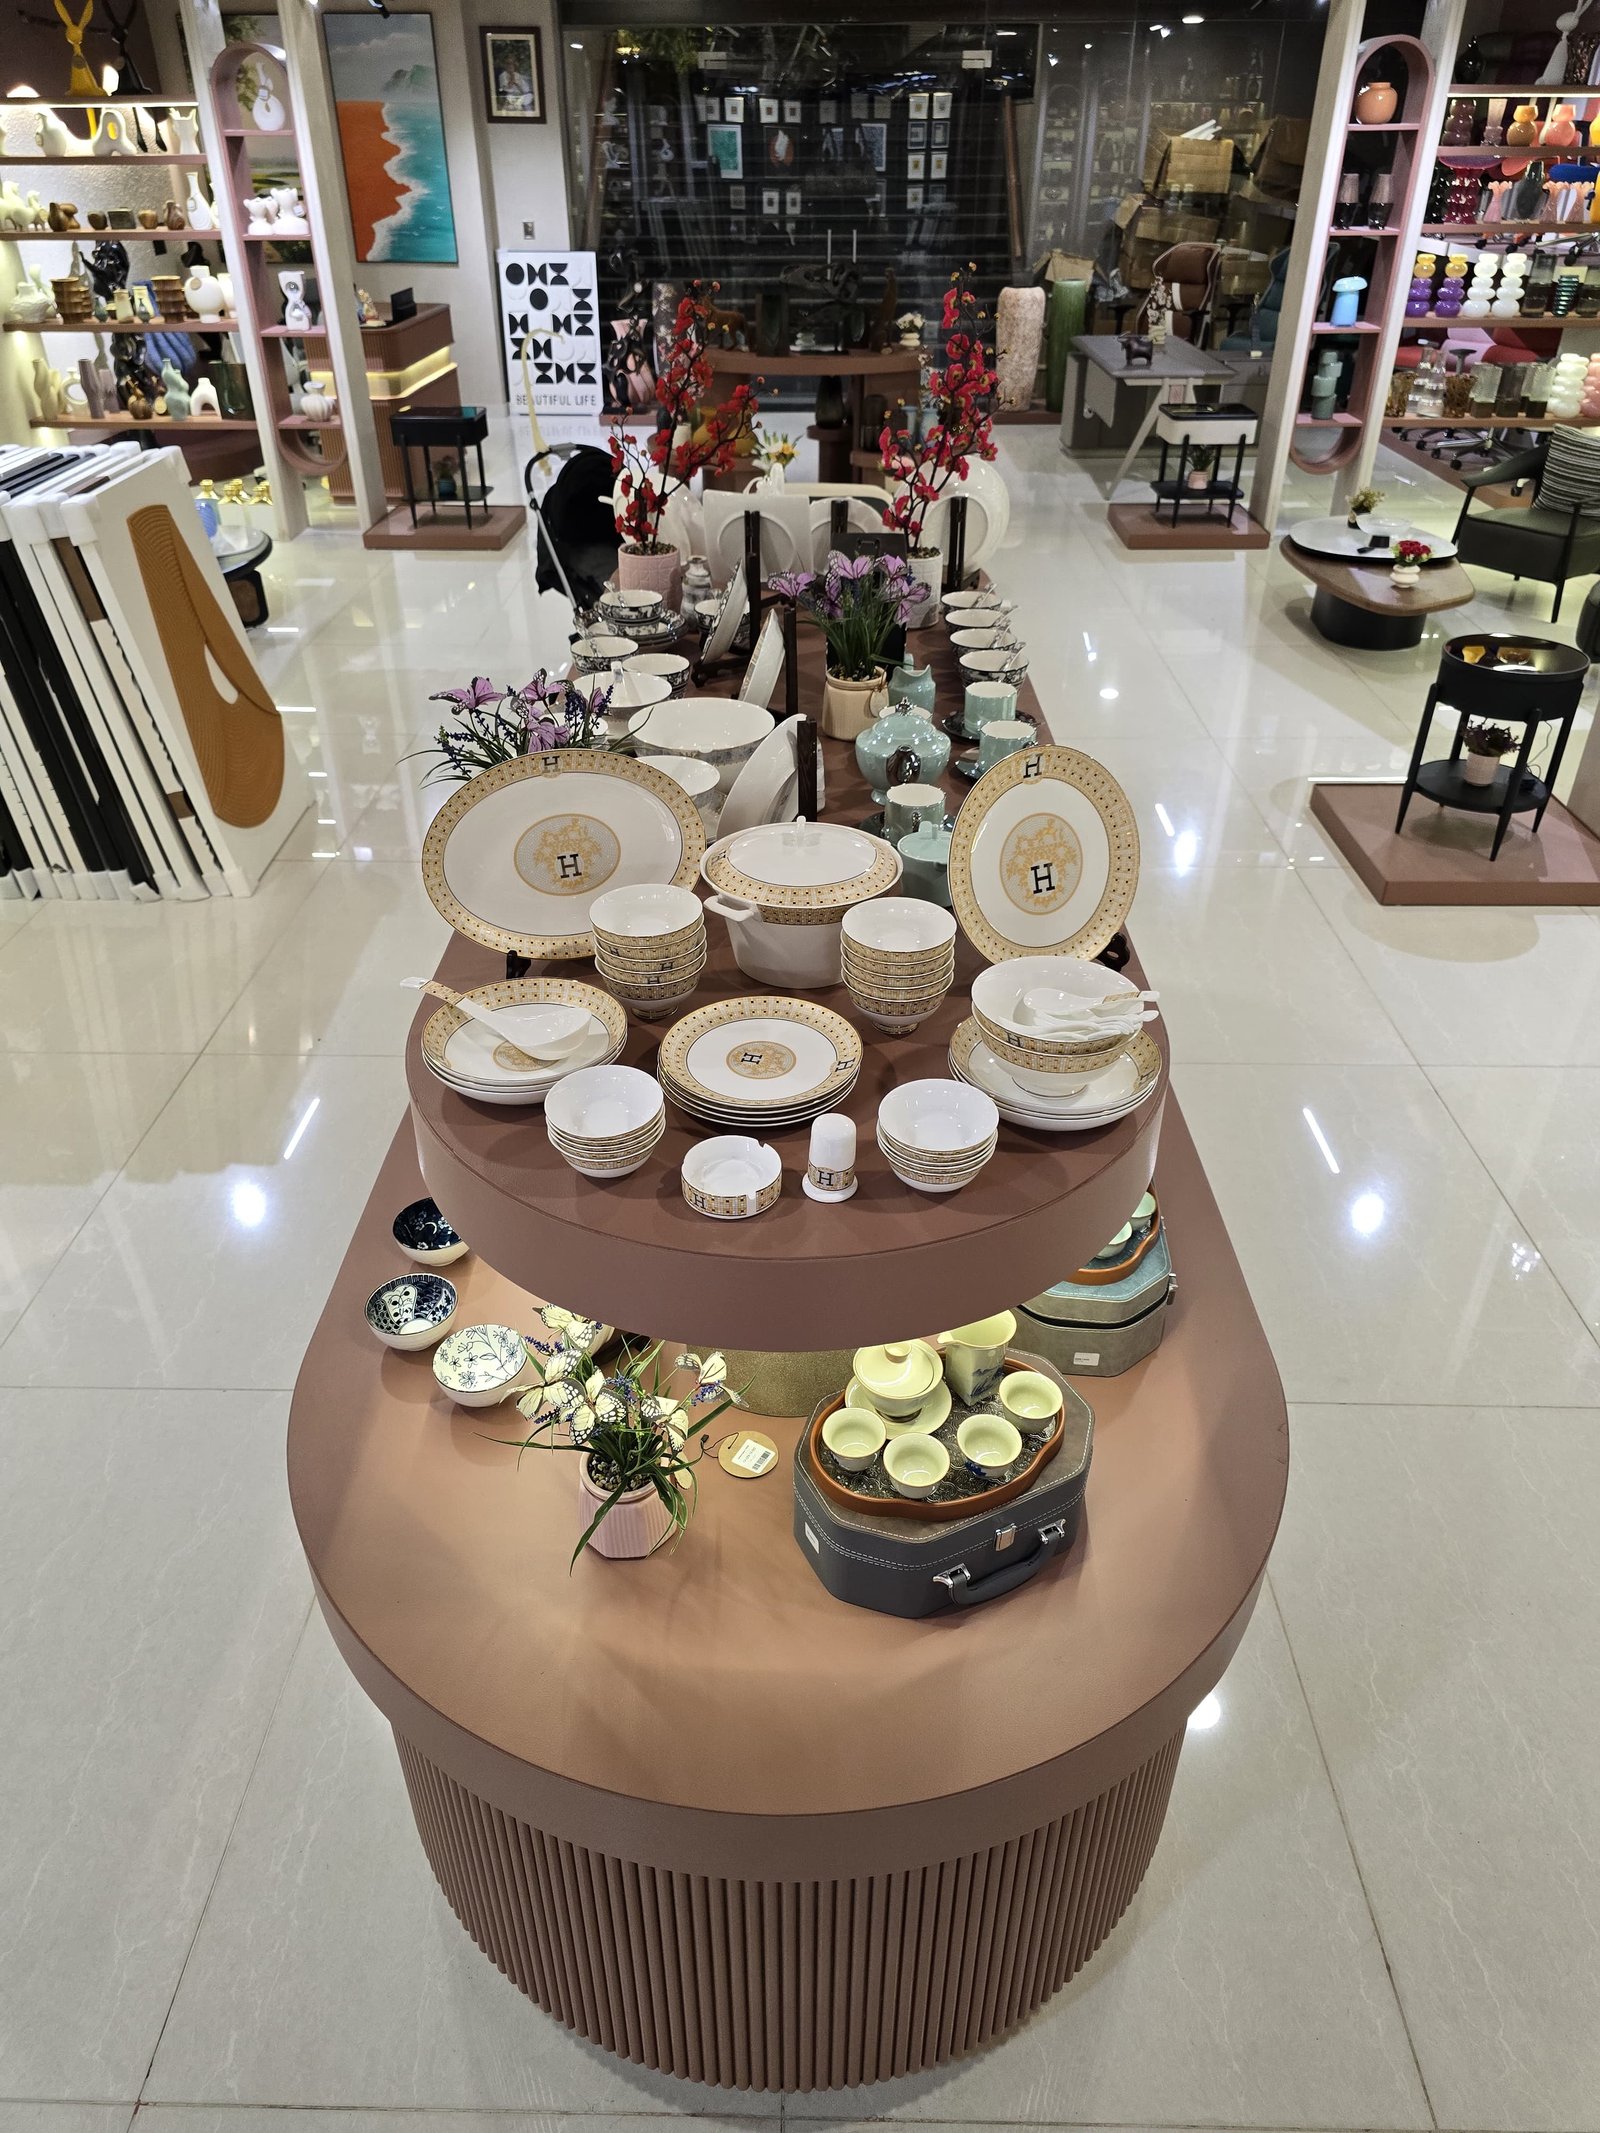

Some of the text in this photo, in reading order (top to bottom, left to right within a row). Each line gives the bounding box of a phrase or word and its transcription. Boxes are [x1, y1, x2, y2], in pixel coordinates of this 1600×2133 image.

[517, 394, 597, 406] BEUTIFUL LIFE
[542, 756, 560, 772] H
[1023, 753, 1044, 778] H
[557, 853, 583, 879] H
[1030, 863, 1055, 894] H
[1005, 1032, 1023, 1048] H
[741, 1052, 763, 1065] H
[835, 1057, 856, 1074] H
[817, 1170, 834, 1186] H
[693, 1193, 706, 1210] H
